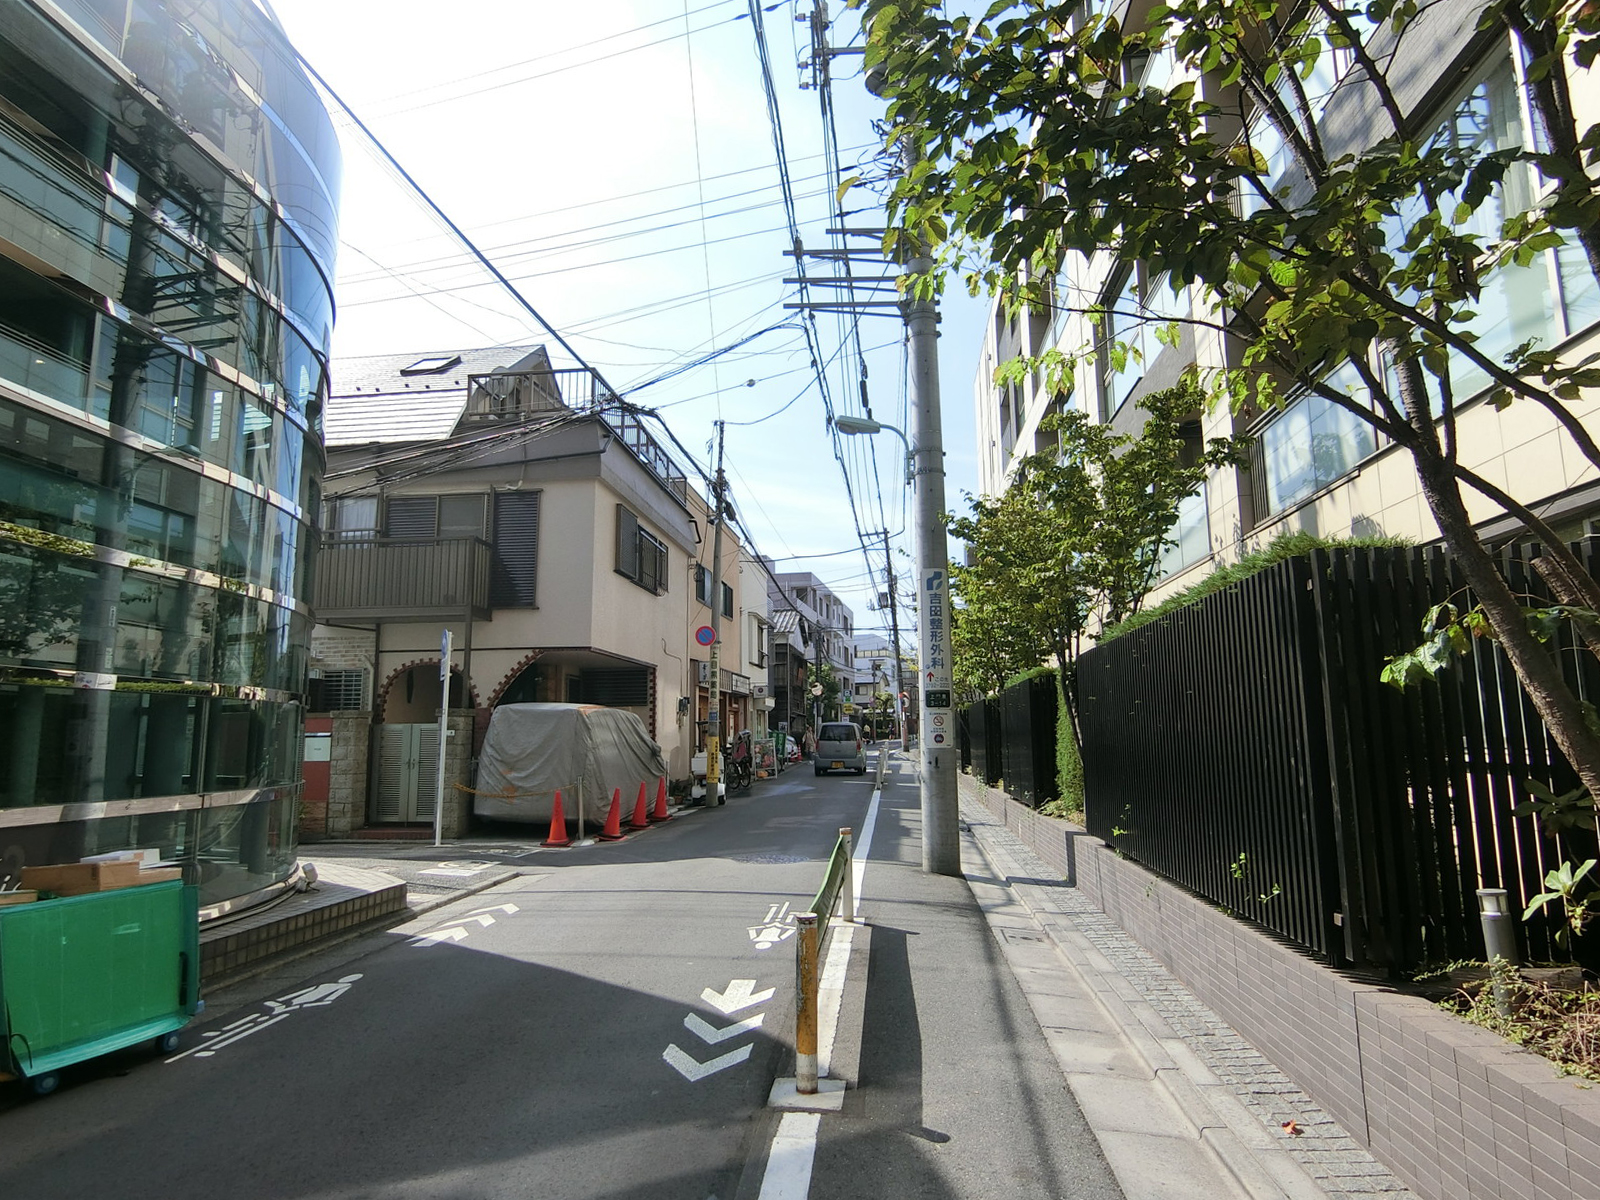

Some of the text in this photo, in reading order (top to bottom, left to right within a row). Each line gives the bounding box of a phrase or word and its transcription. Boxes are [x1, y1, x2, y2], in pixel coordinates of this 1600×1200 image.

[929, 592, 944, 669] 吉田整形外科
